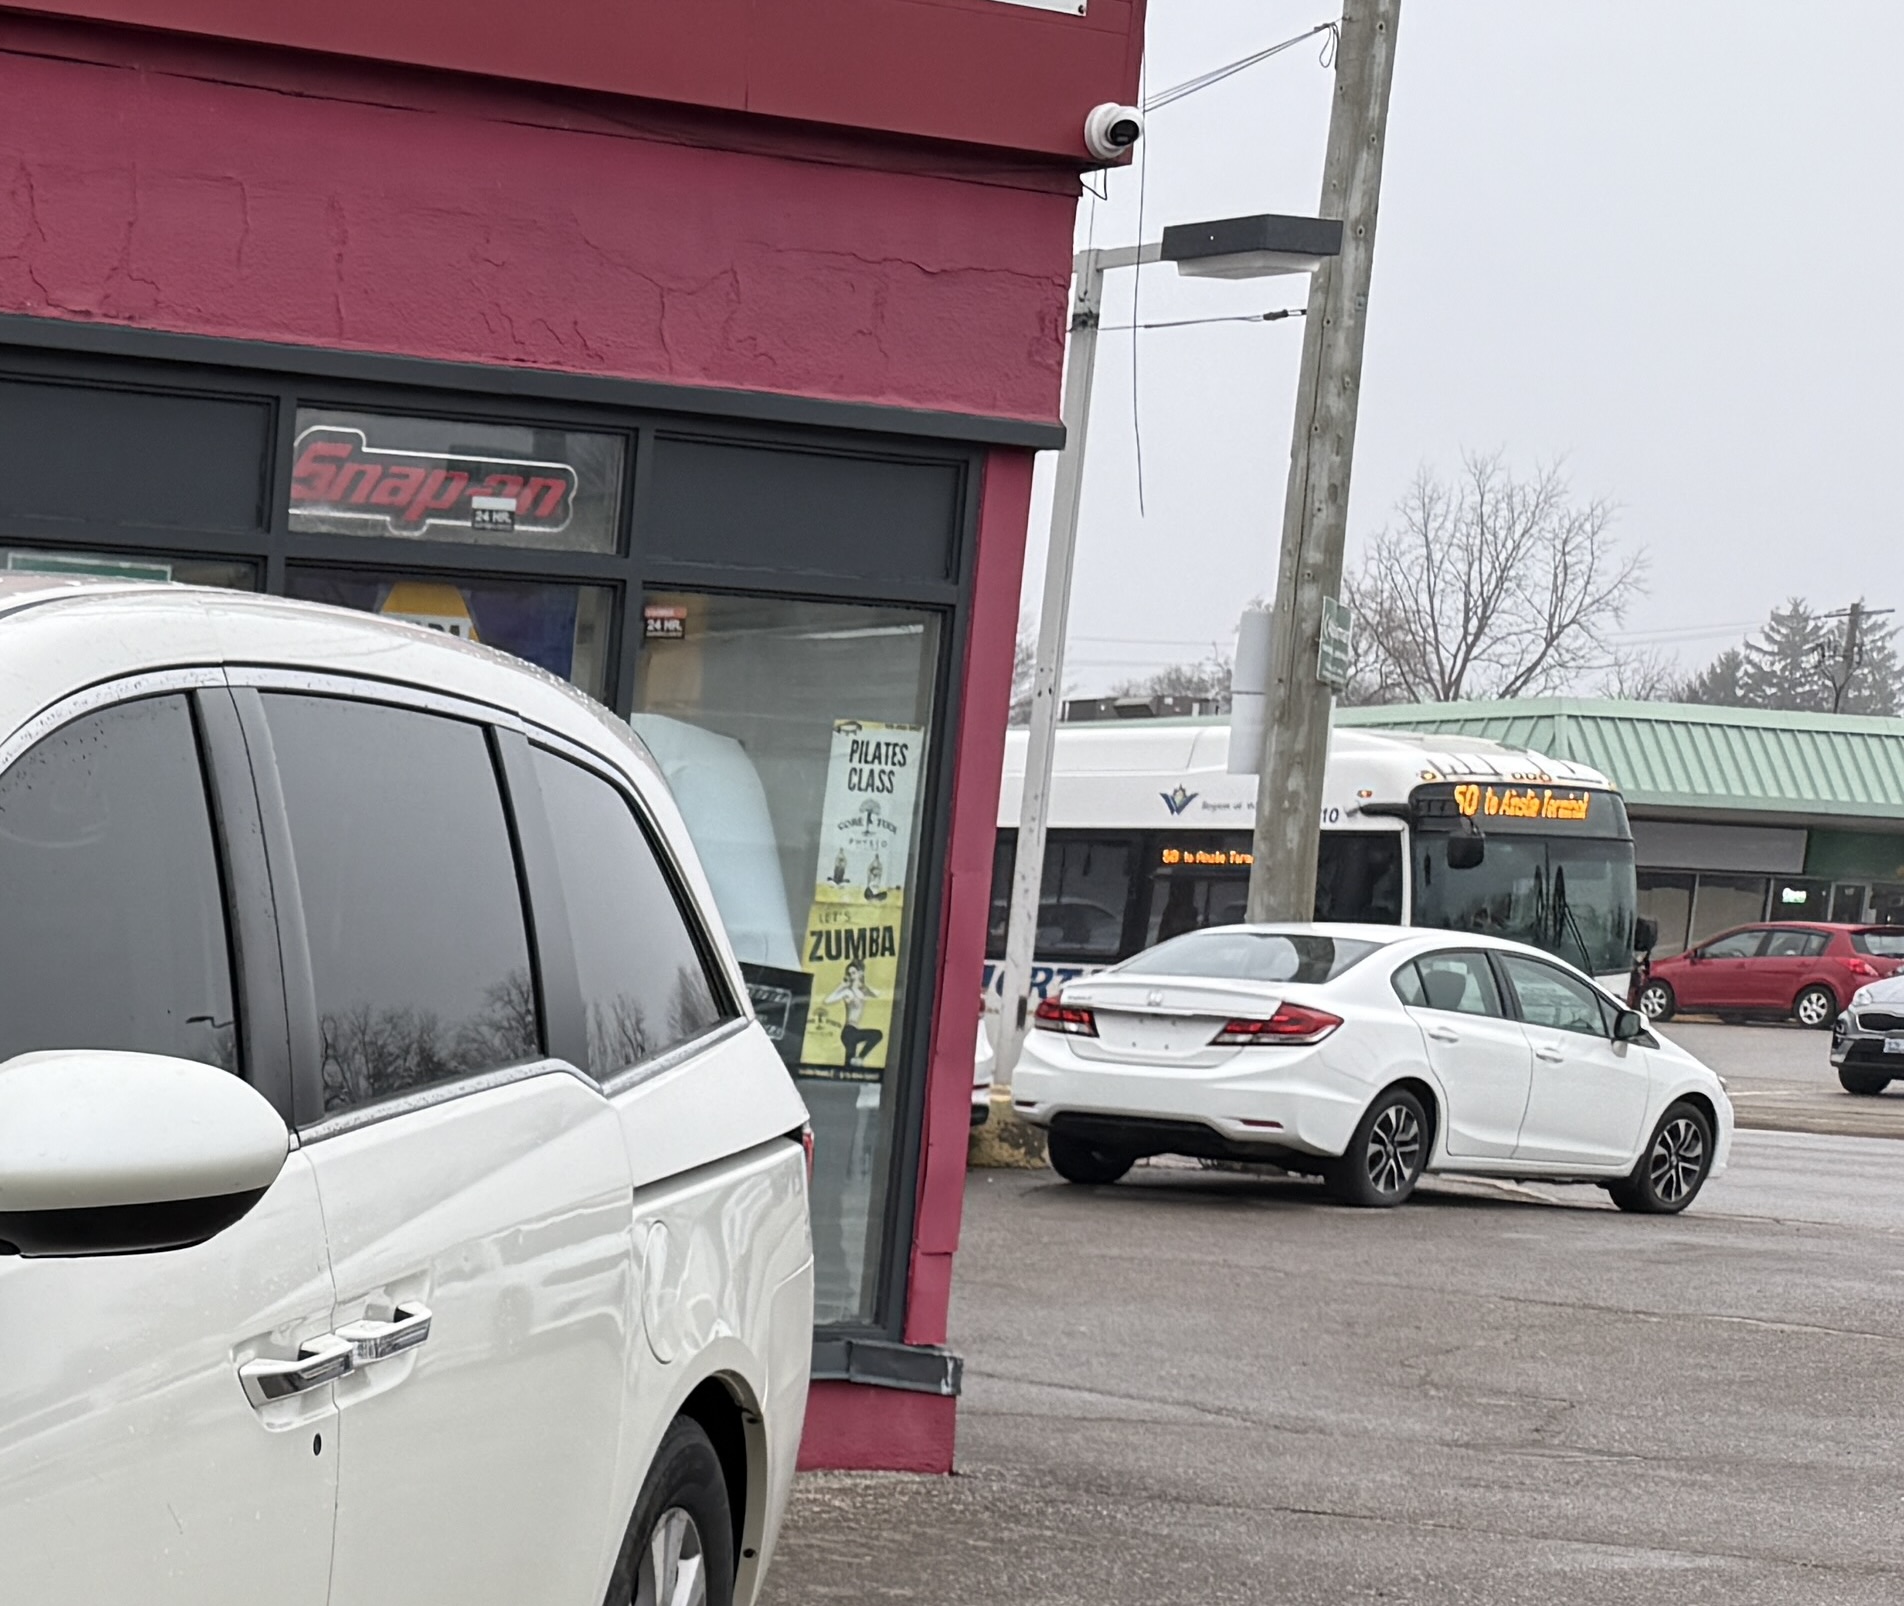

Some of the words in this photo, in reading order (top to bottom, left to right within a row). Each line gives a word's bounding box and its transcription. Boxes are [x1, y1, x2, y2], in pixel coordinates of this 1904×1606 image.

[849, 738, 909, 768] PILATES
[848, 767, 896, 795] CLASS
[809, 925, 896, 962] ZUMBA
